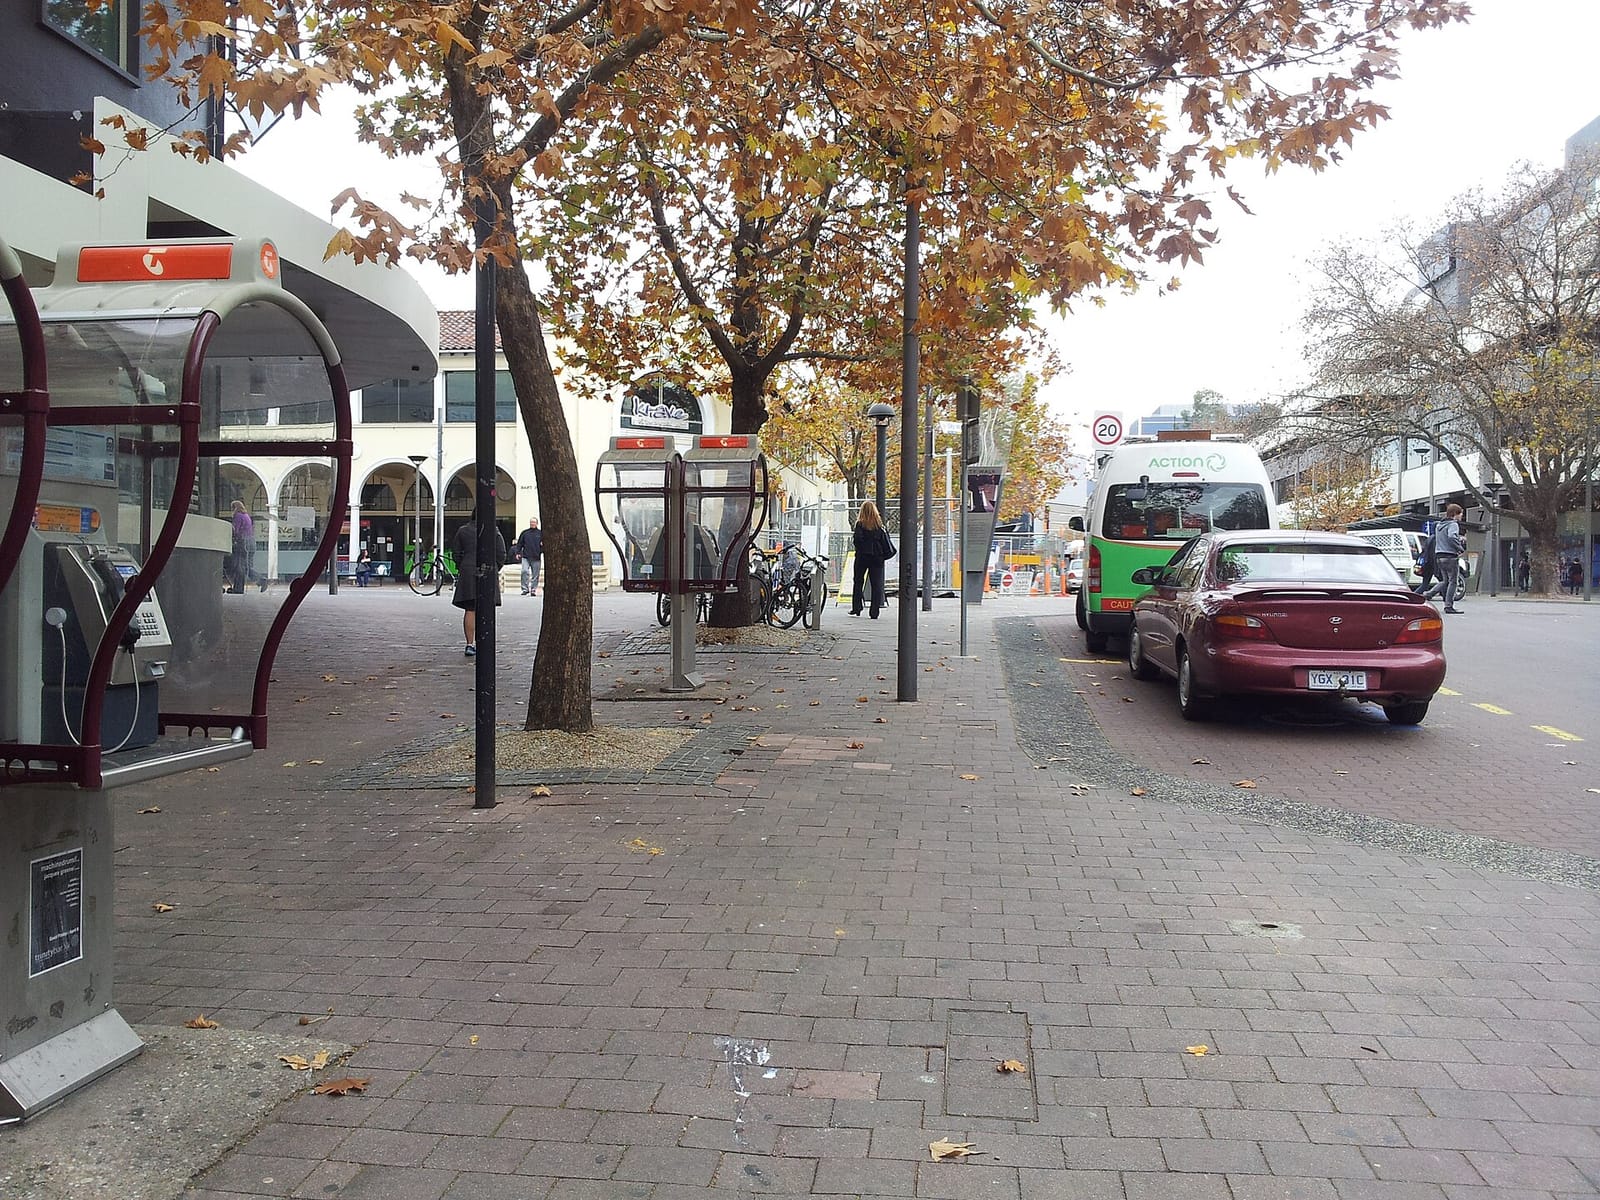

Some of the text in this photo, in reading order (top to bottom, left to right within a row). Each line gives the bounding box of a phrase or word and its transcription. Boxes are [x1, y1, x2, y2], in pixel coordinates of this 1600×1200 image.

[1098, 423, 1117, 437] 20
[1148, 457, 1203, 468] ACTION
[1477, 510, 1485, 522] 7
[1311, 673, 1333, 685] YGX
